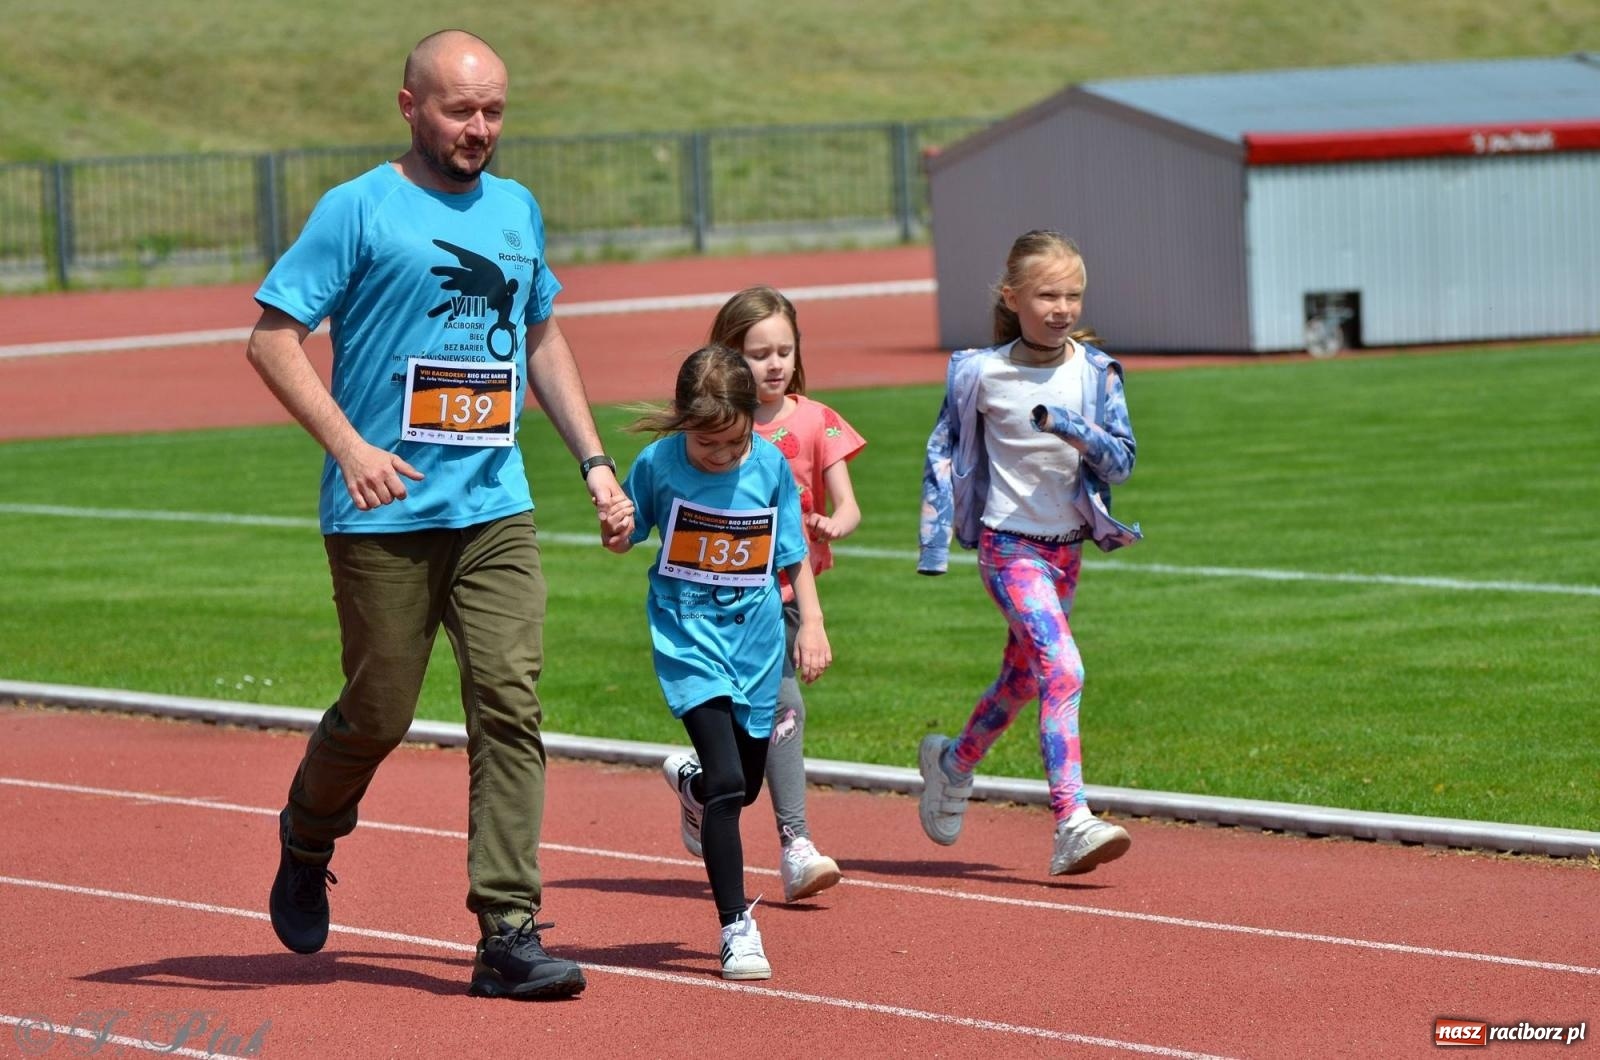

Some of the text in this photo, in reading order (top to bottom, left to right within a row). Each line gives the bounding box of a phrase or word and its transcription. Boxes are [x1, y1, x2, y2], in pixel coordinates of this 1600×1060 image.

[451, 296, 487, 318] VIII
[443, 322, 485, 330] RACIBORSKI
[469, 333, 485, 341] BIEG
[460, 344, 484, 352] BARIER
[439, 393, 493, 424] 139
[698, 536, 752, 566] 135
